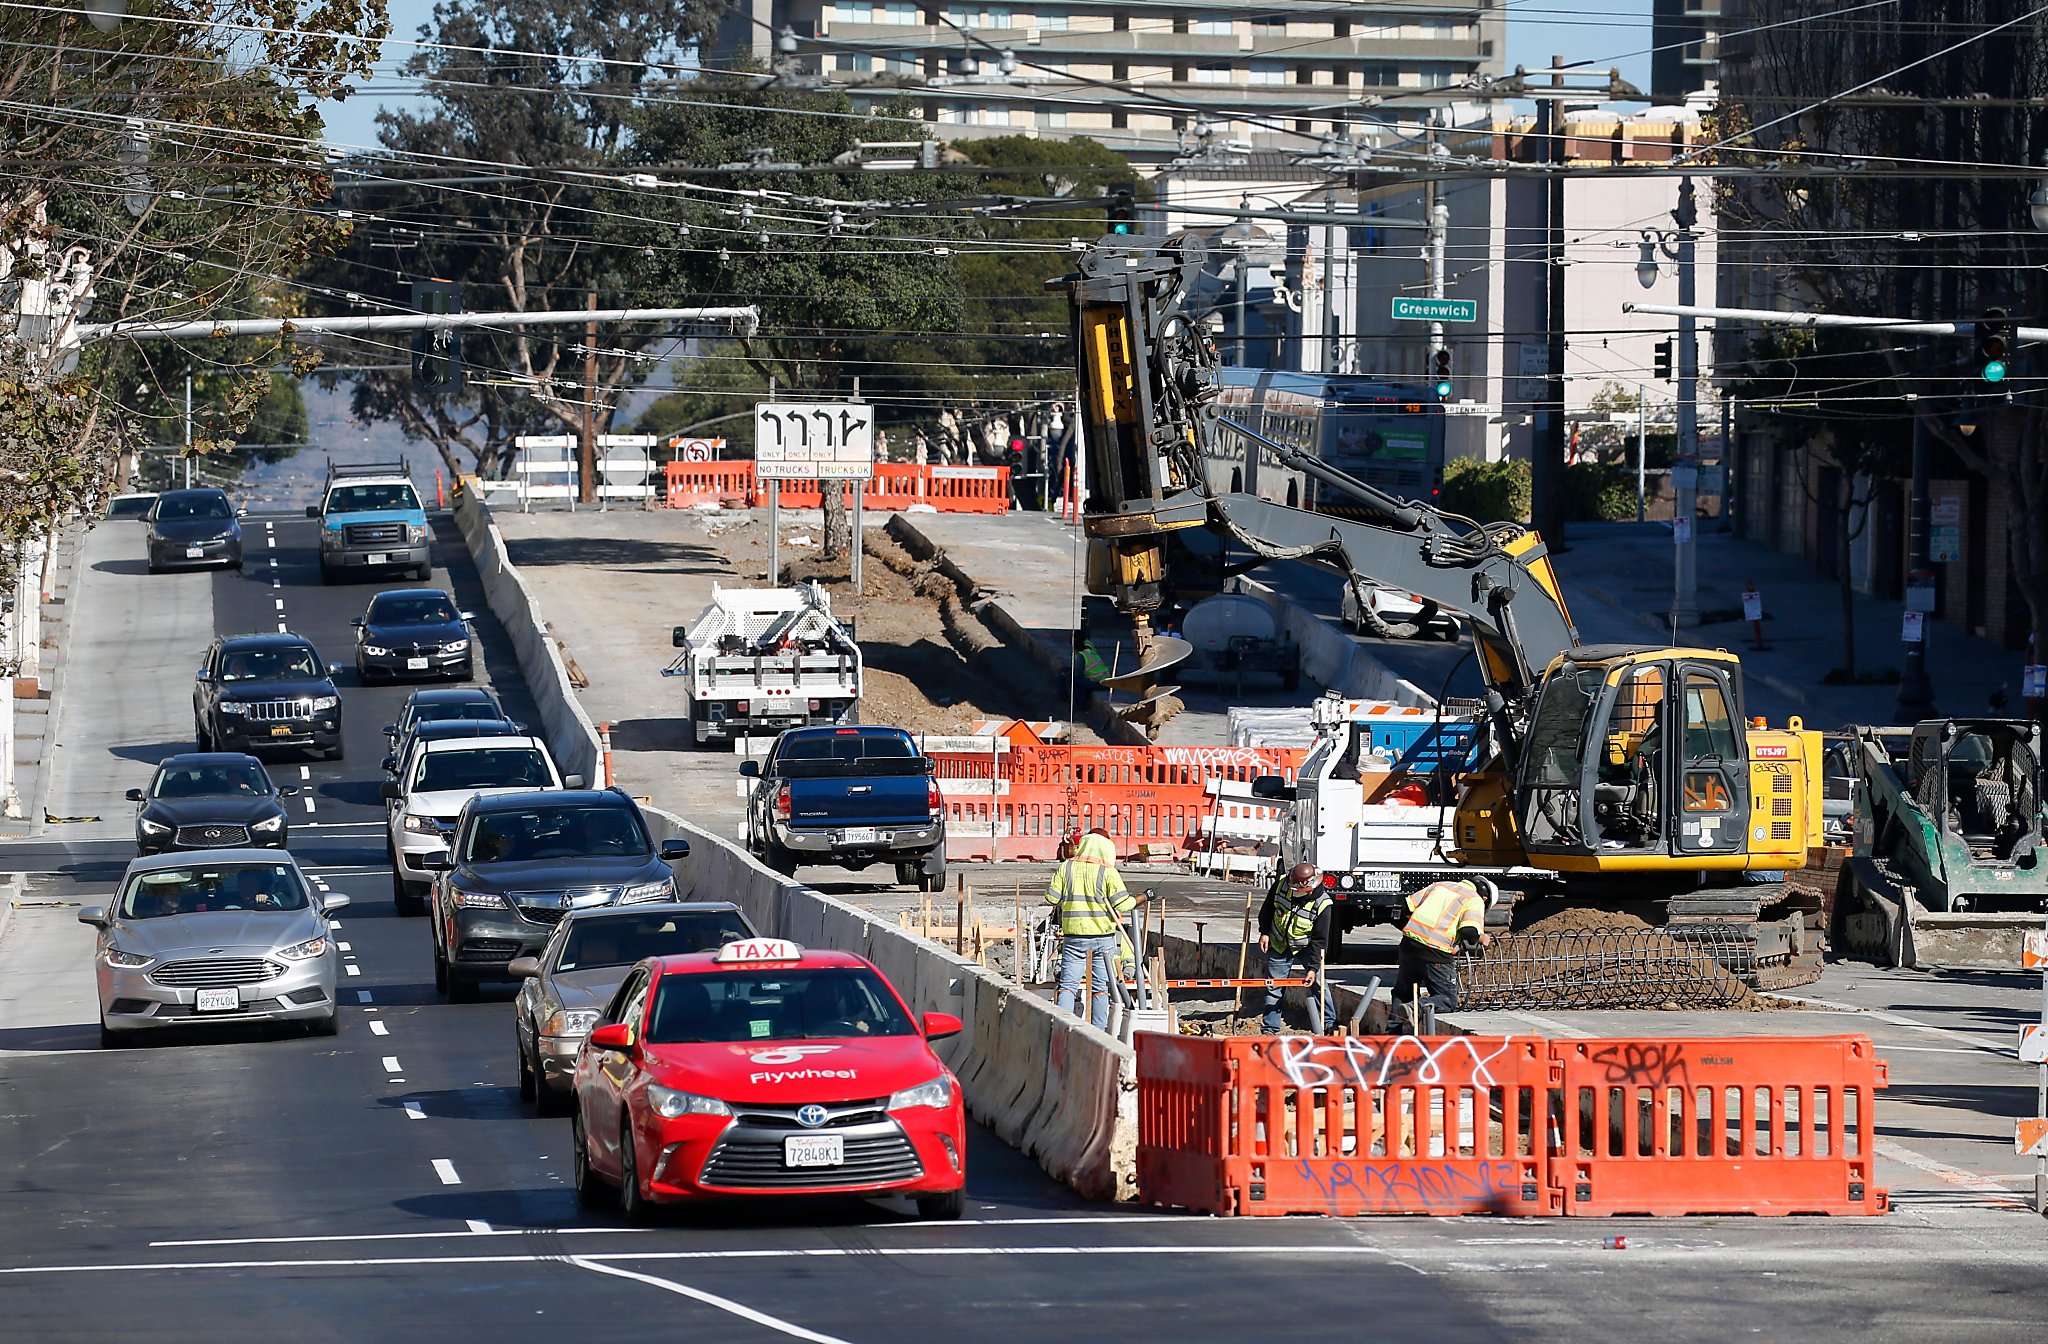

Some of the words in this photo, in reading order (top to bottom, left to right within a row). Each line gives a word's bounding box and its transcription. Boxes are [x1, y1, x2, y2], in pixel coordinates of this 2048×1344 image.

[1400, 302, 1469, 317] Greenwich
[1107, 312, 1127, 410] PHOENIX
[759, 465, 772, 474] NO
[775, 465, 810, 474] TRUCKS
[820, 465, 855, 474] TRUCKS
[857, 466, 869, 474] OK
[710, 702, 725, 720] R
[944, 740, 976, 749] WALSH
[1366, 880, 1399, 889] 30311T2
[731, 943, 785, 959] TAXI
[200, 996, 235, 1008] 8PZY404
[1700, 1057, 1734, 1066] WALSH
[750, 1068, 858, 1085] Flywheel
[790, 1147, 840, 1162] 72848K1
